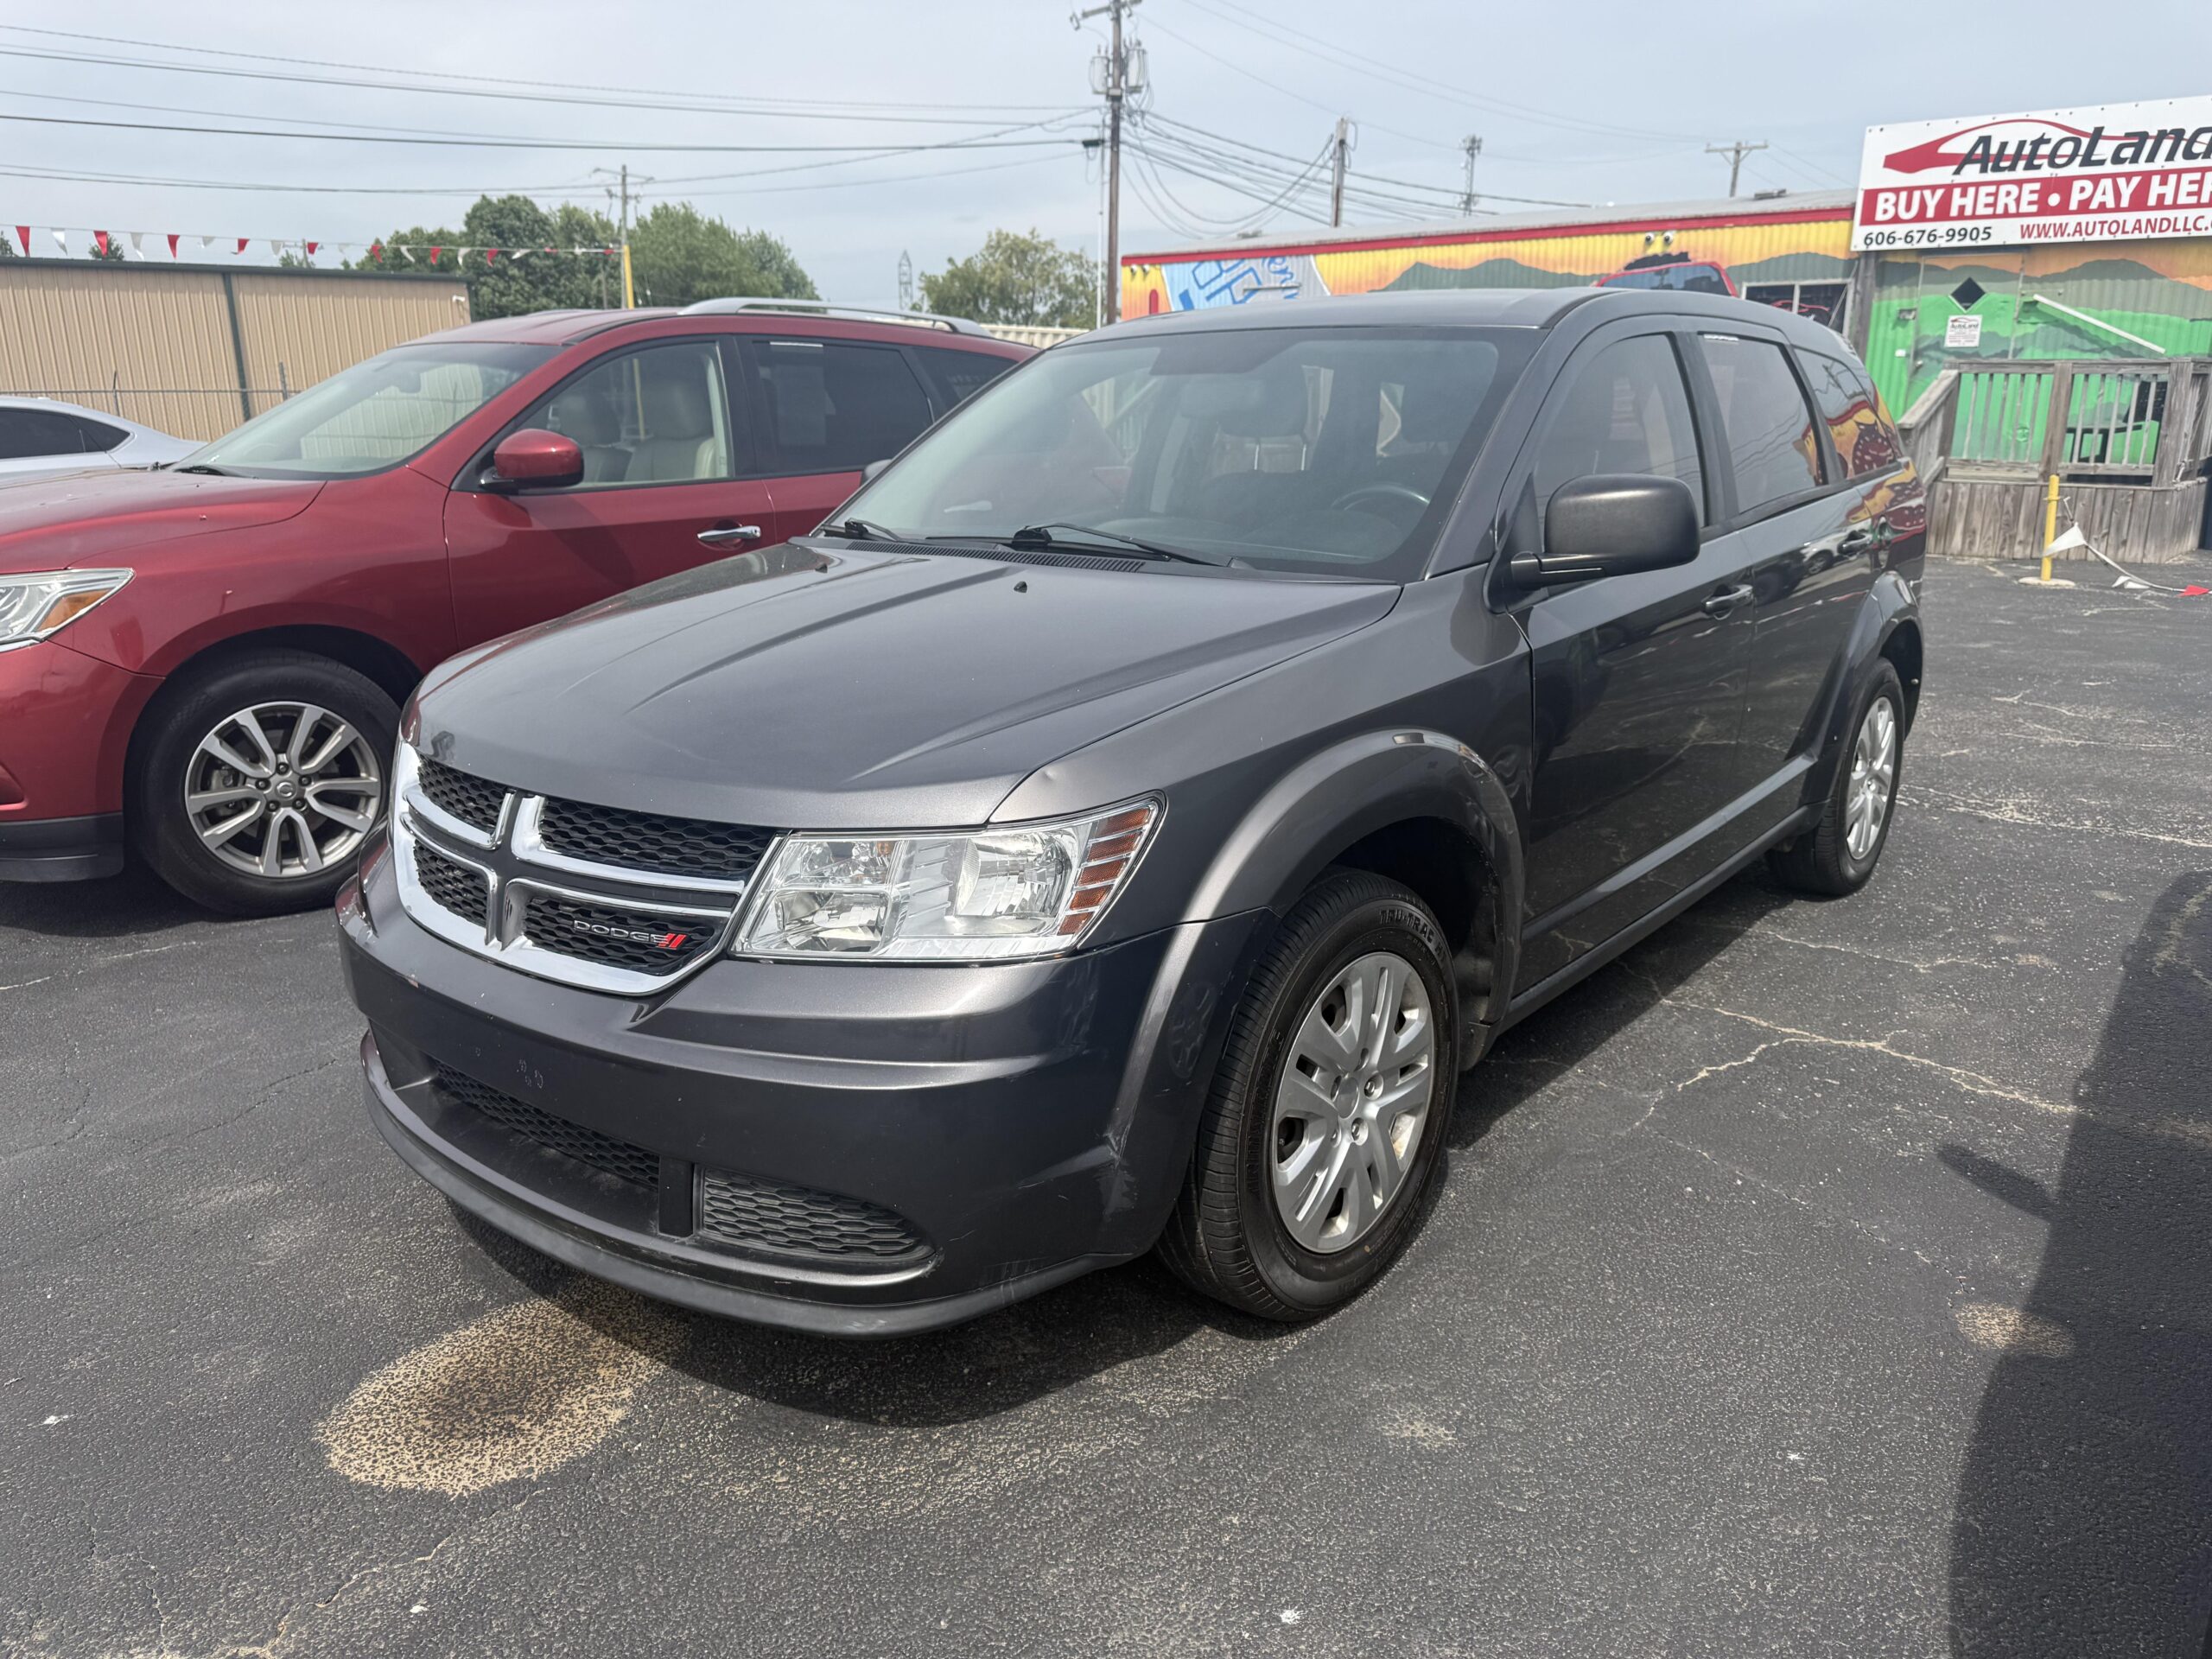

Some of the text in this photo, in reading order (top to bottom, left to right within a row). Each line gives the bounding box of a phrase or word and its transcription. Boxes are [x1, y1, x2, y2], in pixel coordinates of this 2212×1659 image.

[1874, 188, 1945, 222] BUY
[1949, 181, 2042, 217] HERE
[2069, 175, 2143, 211] PAY
[1864, 226, 1993, 247] 606-676-9905
[2019, 215, 2212, 239] WWW.AUTOLANDLLC.
[574, 919, 669, 944] DODGE
